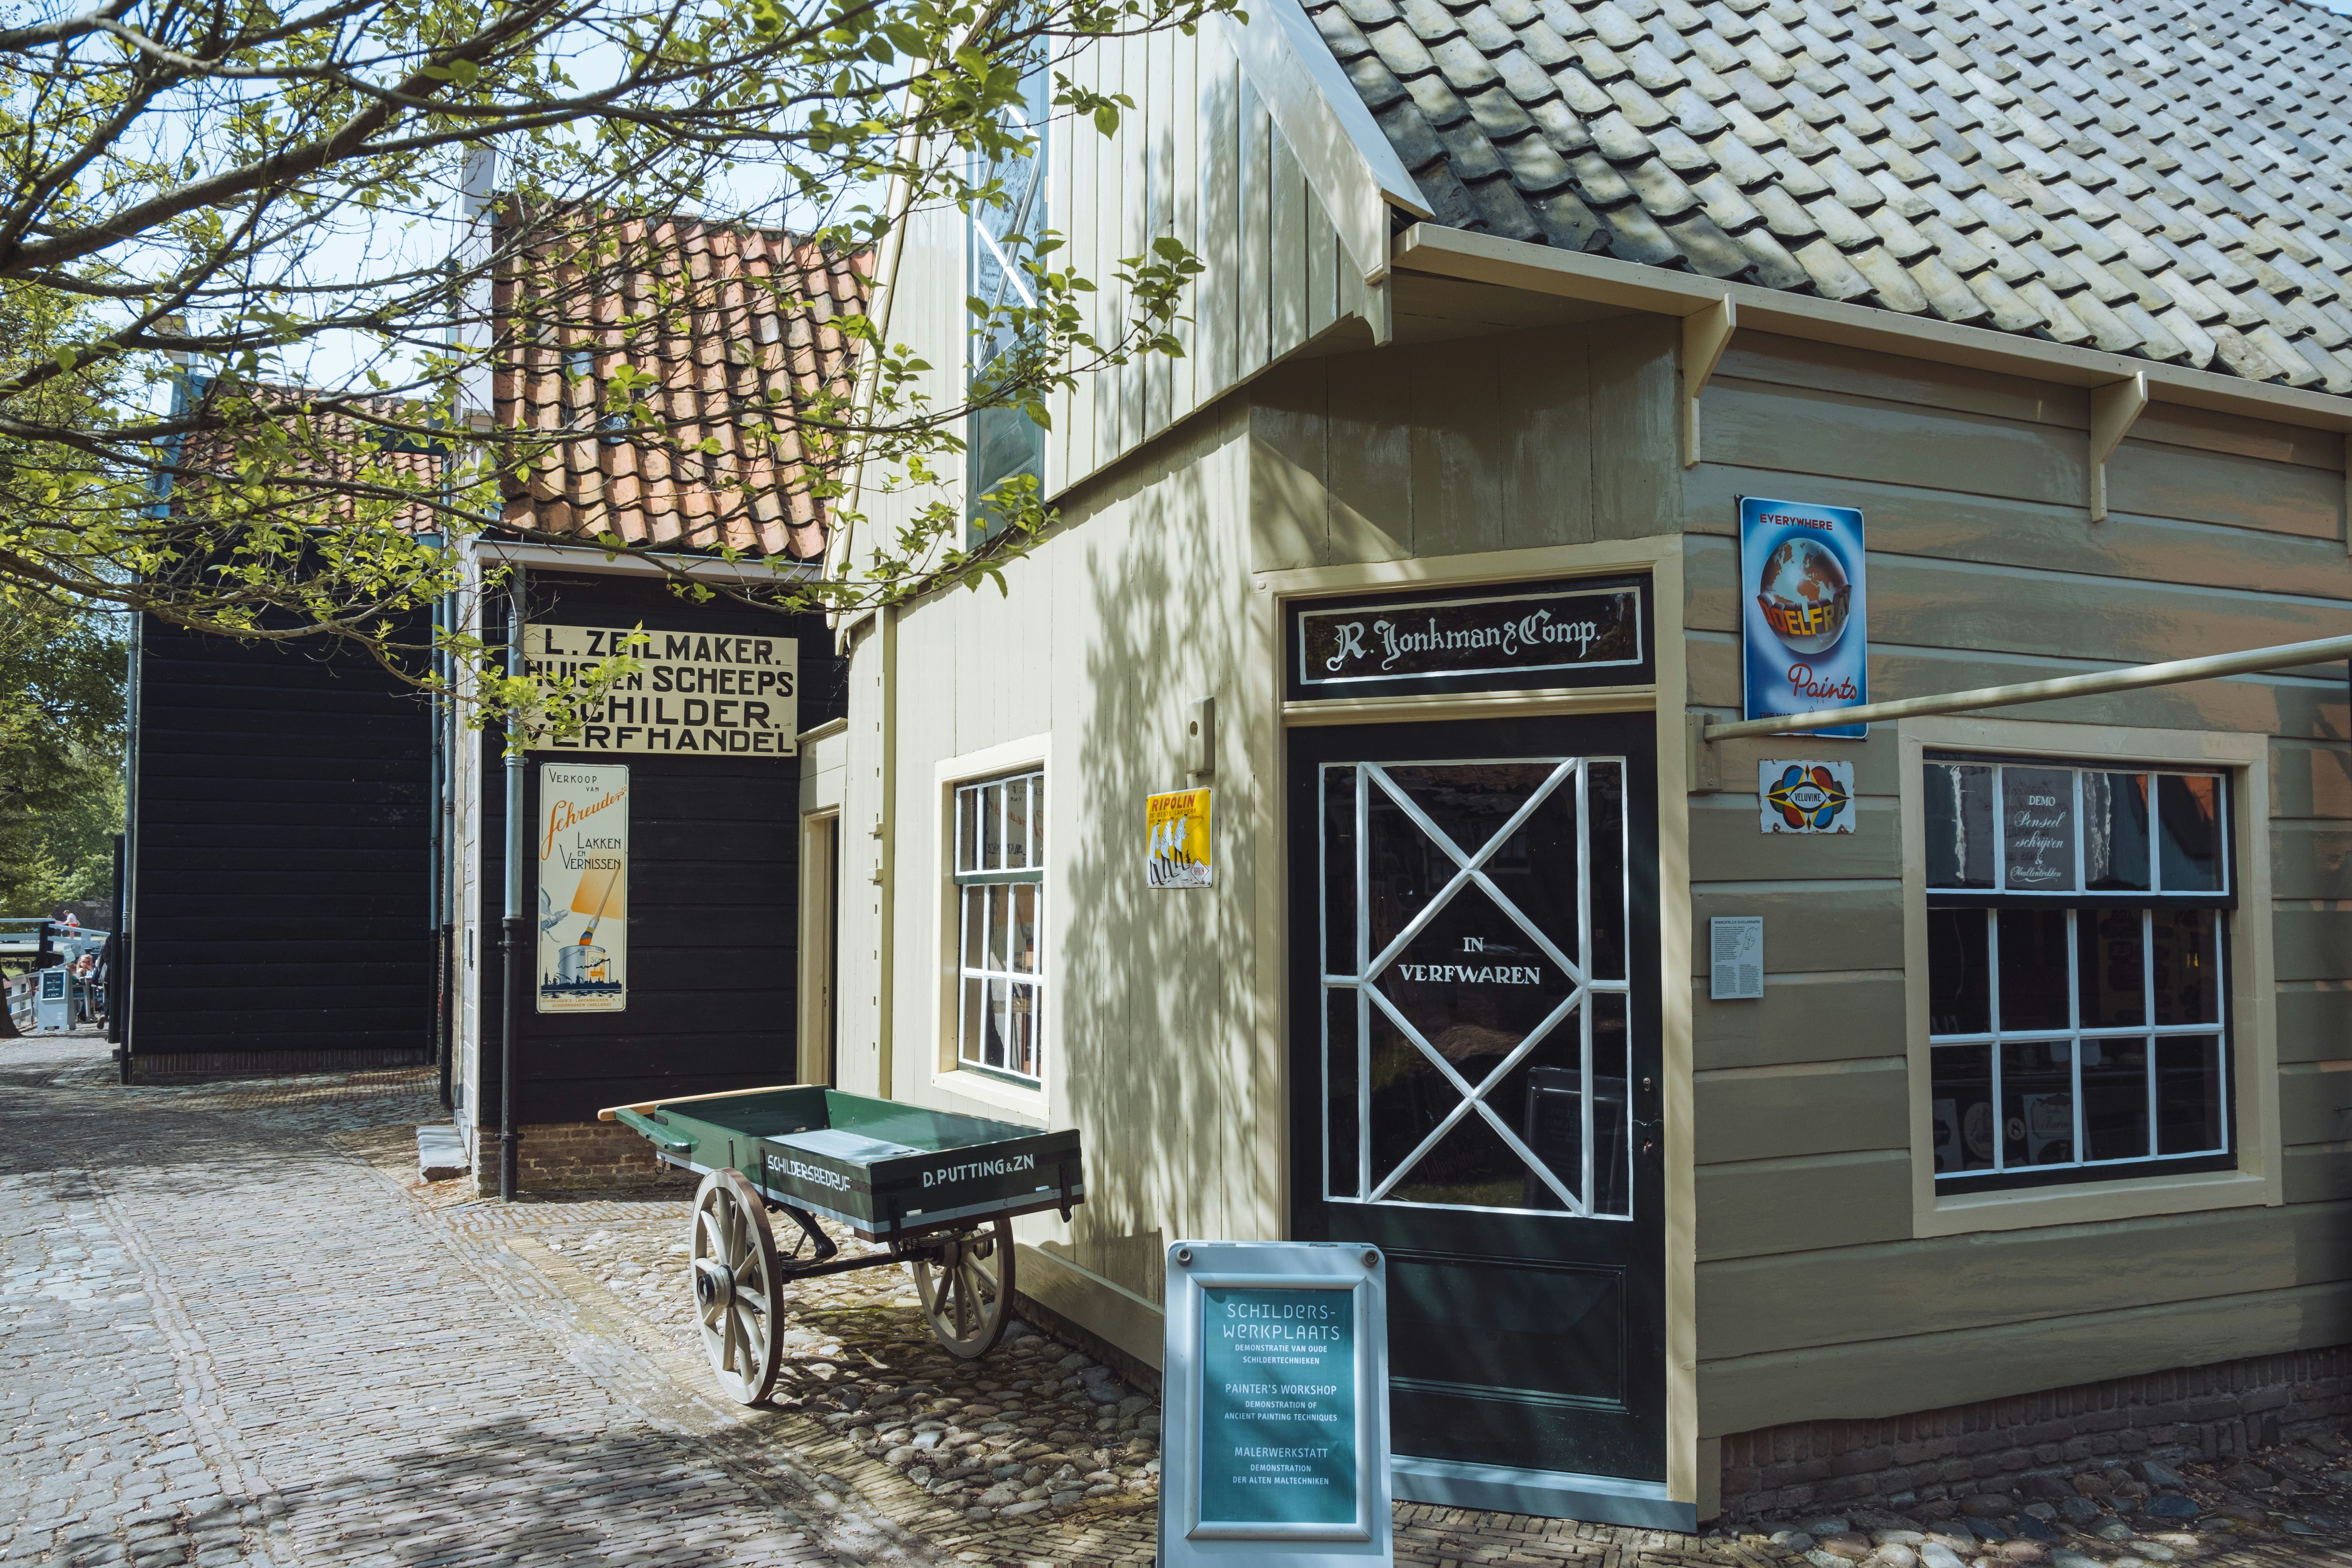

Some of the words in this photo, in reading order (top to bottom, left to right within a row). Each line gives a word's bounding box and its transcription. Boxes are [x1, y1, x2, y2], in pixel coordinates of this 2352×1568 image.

[1759, 513, 1833, 531] EVERYWHERE
[545, 628, 578, 655] L.
[586, 630, 781, 665] ZEILMAKER.
[1374, 617, 1501, 671] Jonkman
[652, 665, 793, 697] SCHEEPS
[1788, 663, 1857, 700] Paints
[545, 693, 780, 729] SCHILDER.
[549, 768, 597, 784] VERKOOP
[1152, 794, 1196, 812] RIPOLIN
[1795, 793, 1821, 802] VELUVINE
[2029, 795, 2055, 806] DEMO
[541, 786, 627, 861] Schreuder's
[2014, 810, 2066, 828] Penseel
[577, 831, 621, 849] LAKKEN
[2014, 830, 2065, 855] schrijven
[558, 842, 621, 870] VERNISSEN
[1463, 937, 1484, 952] IN
[1398, 964, 1540, 985] VERFWAREN
[767, 1155, 851, 1192] SCHILDERSBEDRIJF
[1235, 1344, 1289, 1352] DEMONSTRATIE
[1243, 1356, 1320, 1364] SCHILDERTECHNIEKEN
[1225, 1383, 1277, 1394] PAINTER'S
[1280, 1384, 1337, 1395] WORKSHOP
[1294, 1413, 1338, 1422] TECHNIQUES
[1234, 1447, 1328, 1458] MALERWERKSTATT
[1250, 1464, 1311, 1472] DEMONSTRATION
[1274, 1476, 1329, 1485] MALTECHNIKEN
